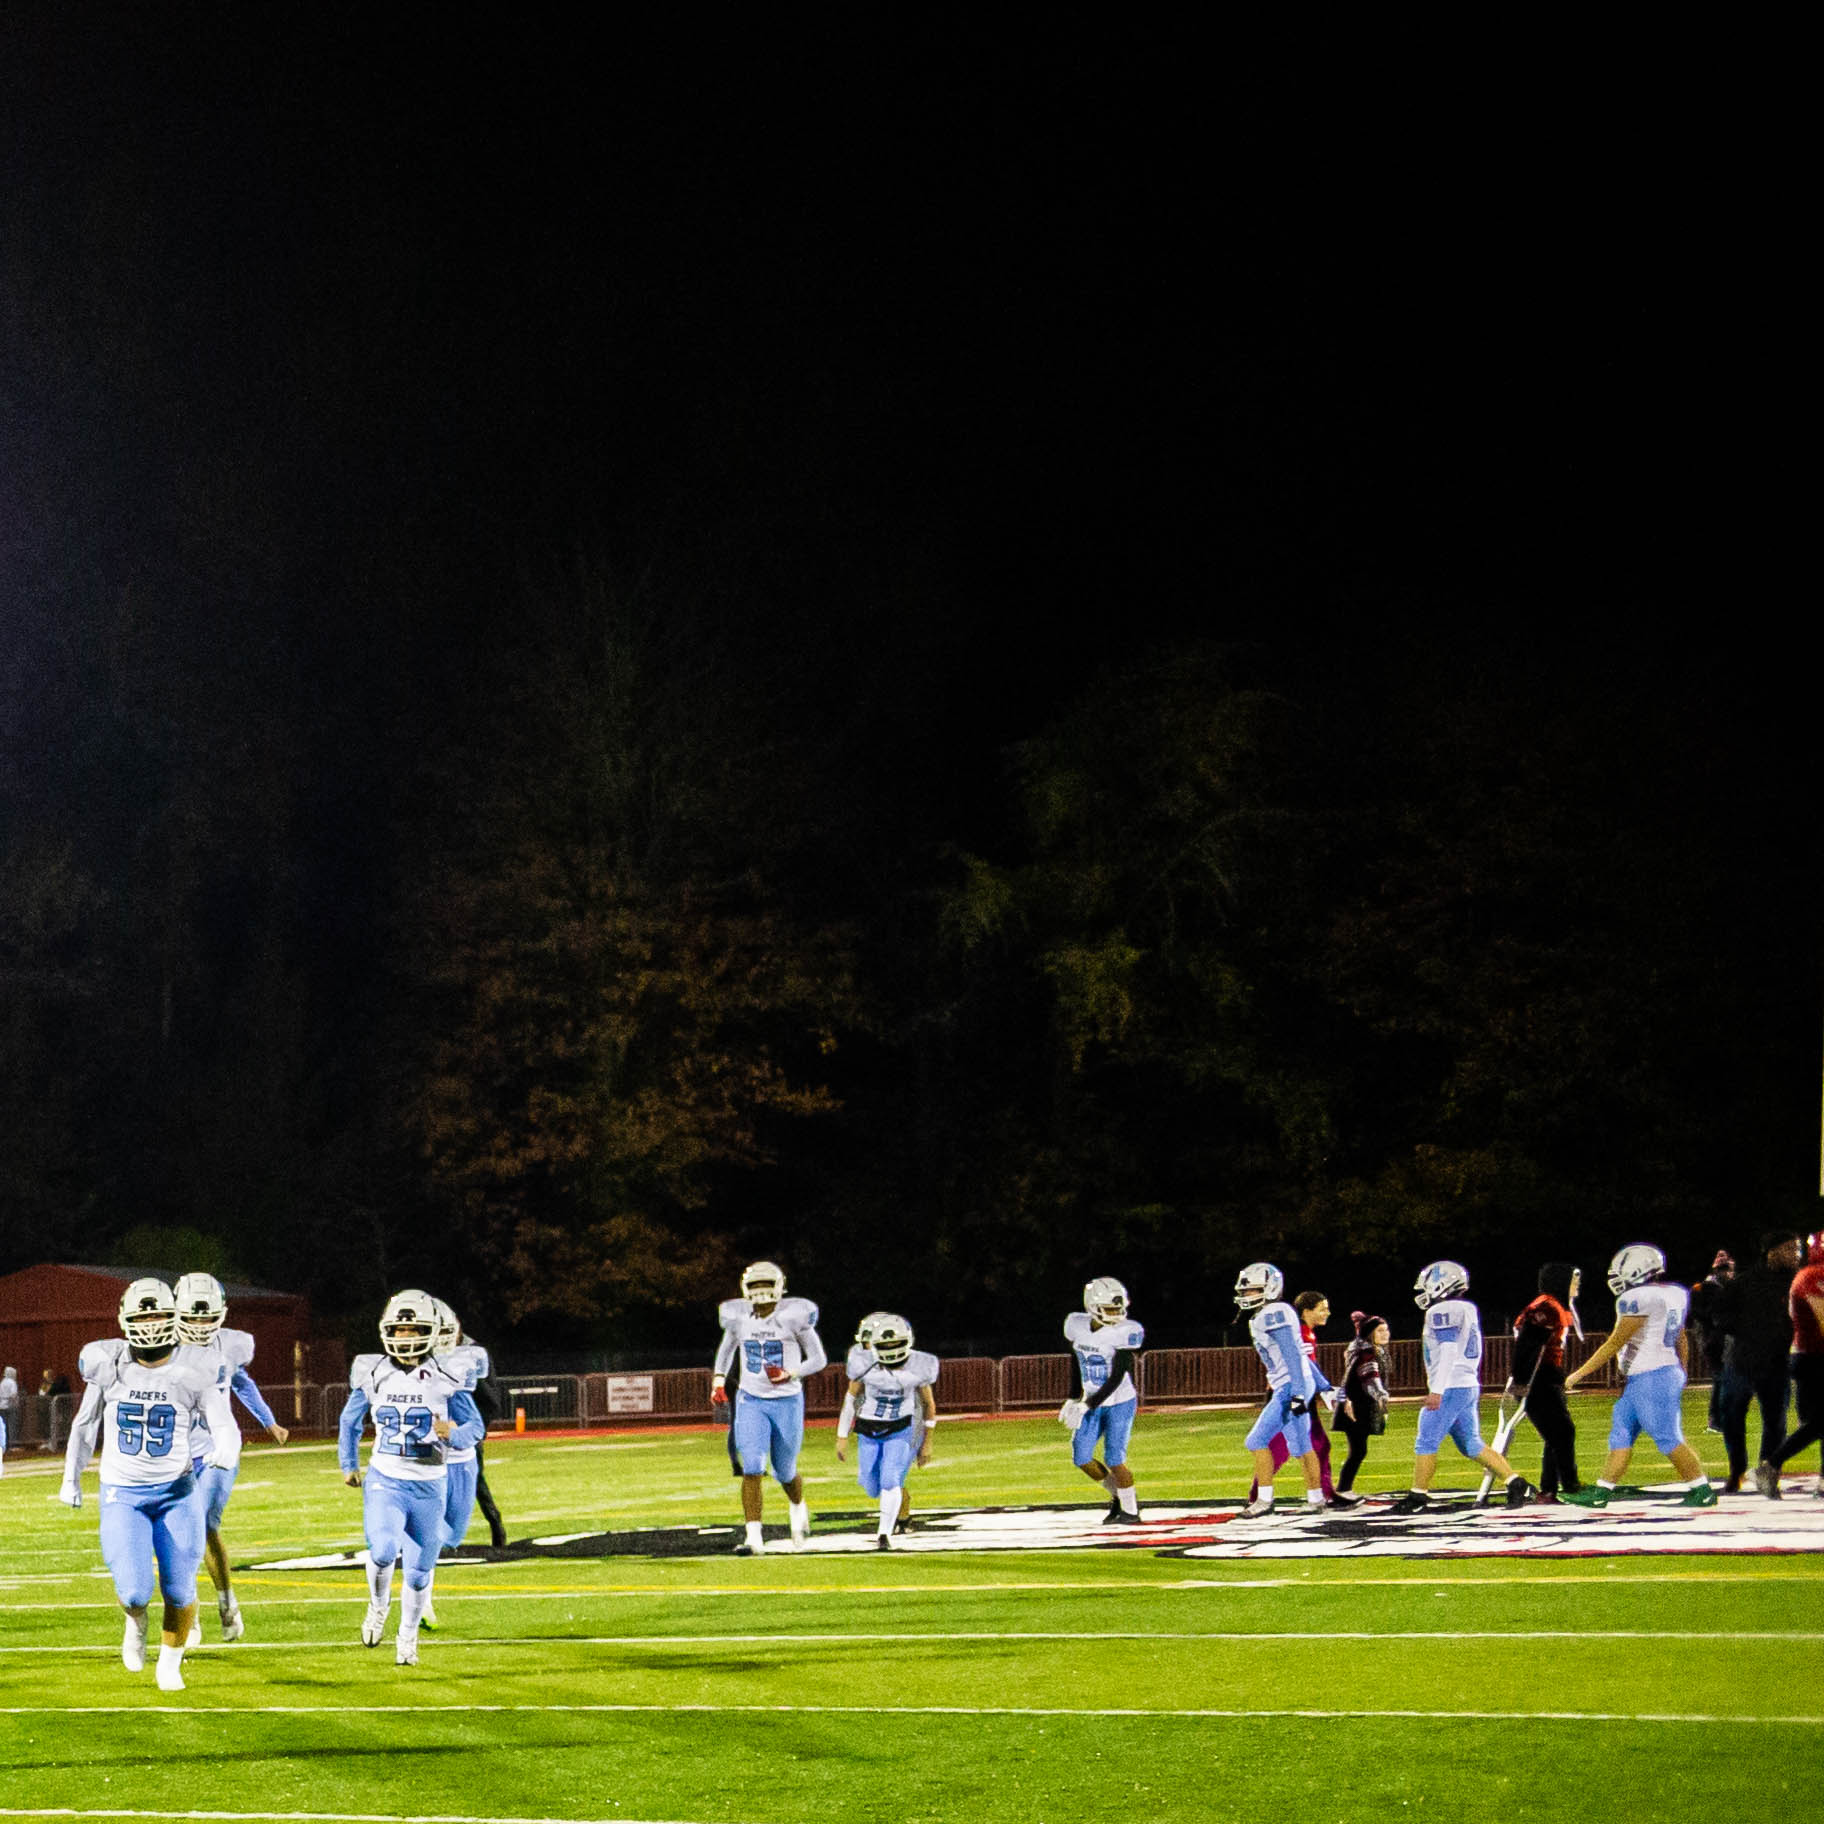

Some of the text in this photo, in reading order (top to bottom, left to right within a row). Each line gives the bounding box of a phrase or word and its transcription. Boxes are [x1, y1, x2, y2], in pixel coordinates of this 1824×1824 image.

[129, 1389, 168, 1401] PACERS
[387, 1394, 423, 1404] PACERS
[117, 1401, 177, 1457] 59
[376, 1405, 433, 1457] 22
